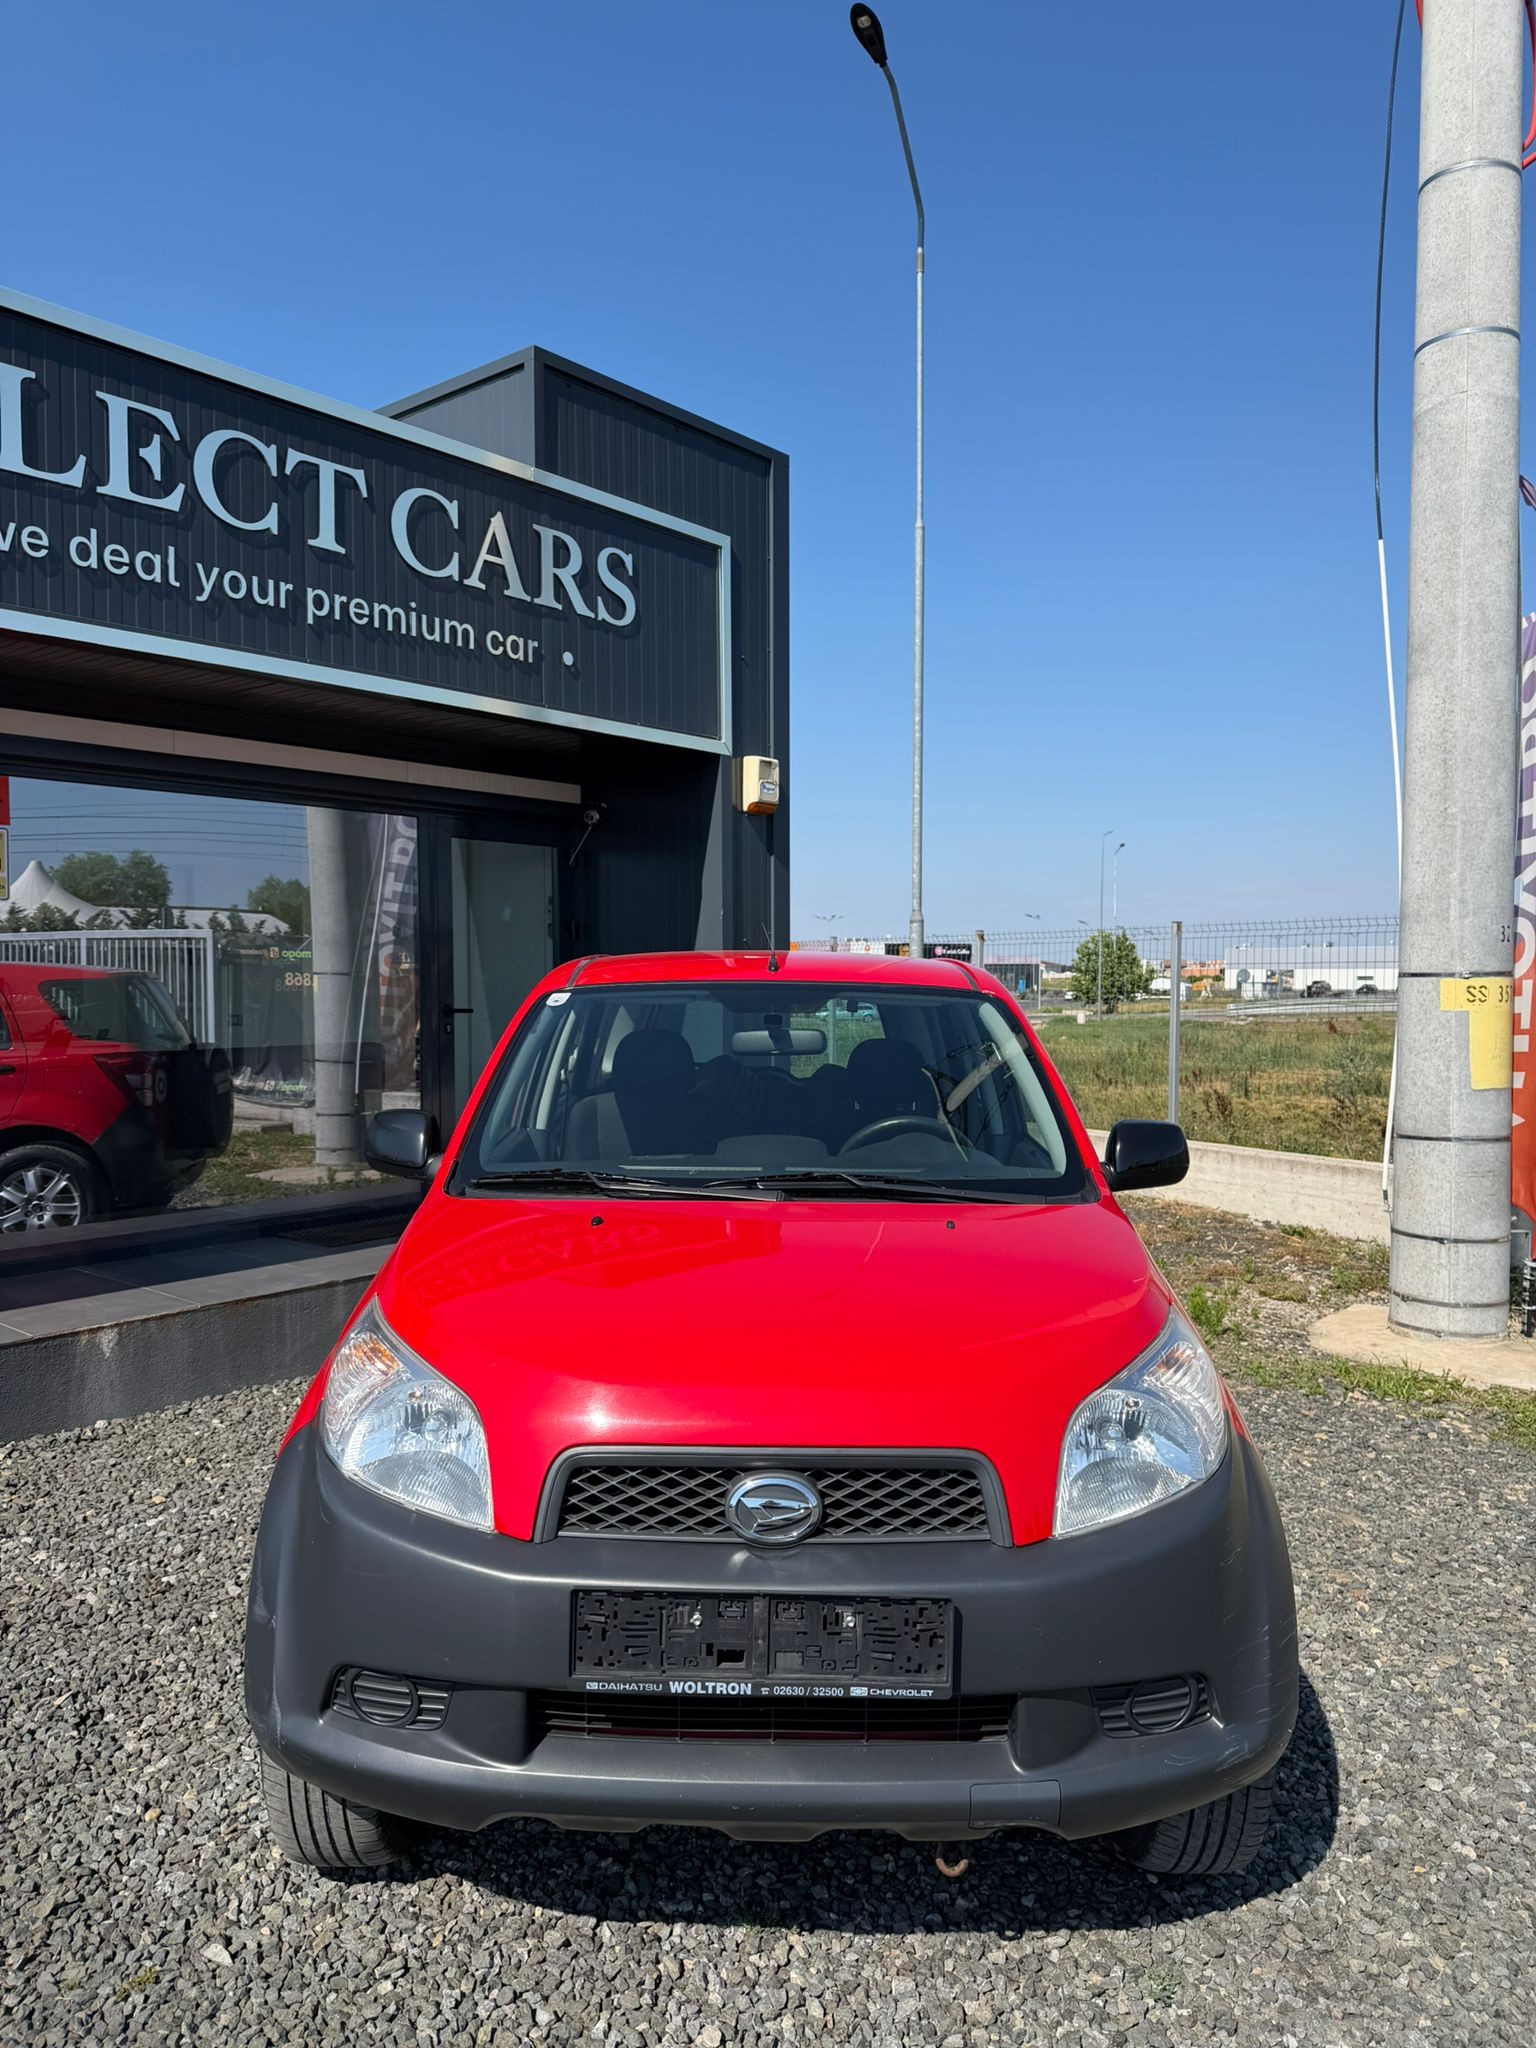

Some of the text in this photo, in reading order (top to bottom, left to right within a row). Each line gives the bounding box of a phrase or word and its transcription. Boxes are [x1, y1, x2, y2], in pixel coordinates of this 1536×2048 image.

[391, 487, 637, 627] CARS
[69, 528, 181, 588] deal
[195, 562, 294, 609] your
[306, 587, 475, 650] premium
[485, 630, 538, 663] car
[1466, 985, 1488, 1003] SS
[599, 1682, 662, 1691] DAIHATSU
[669, 1681, 752, 1695] WOLTRON
[774, 1686, 804, 1695] 02630
[813, 1687, 844, 1696] 32500
[870, 1688, 934, 1697] CHEVROLET
